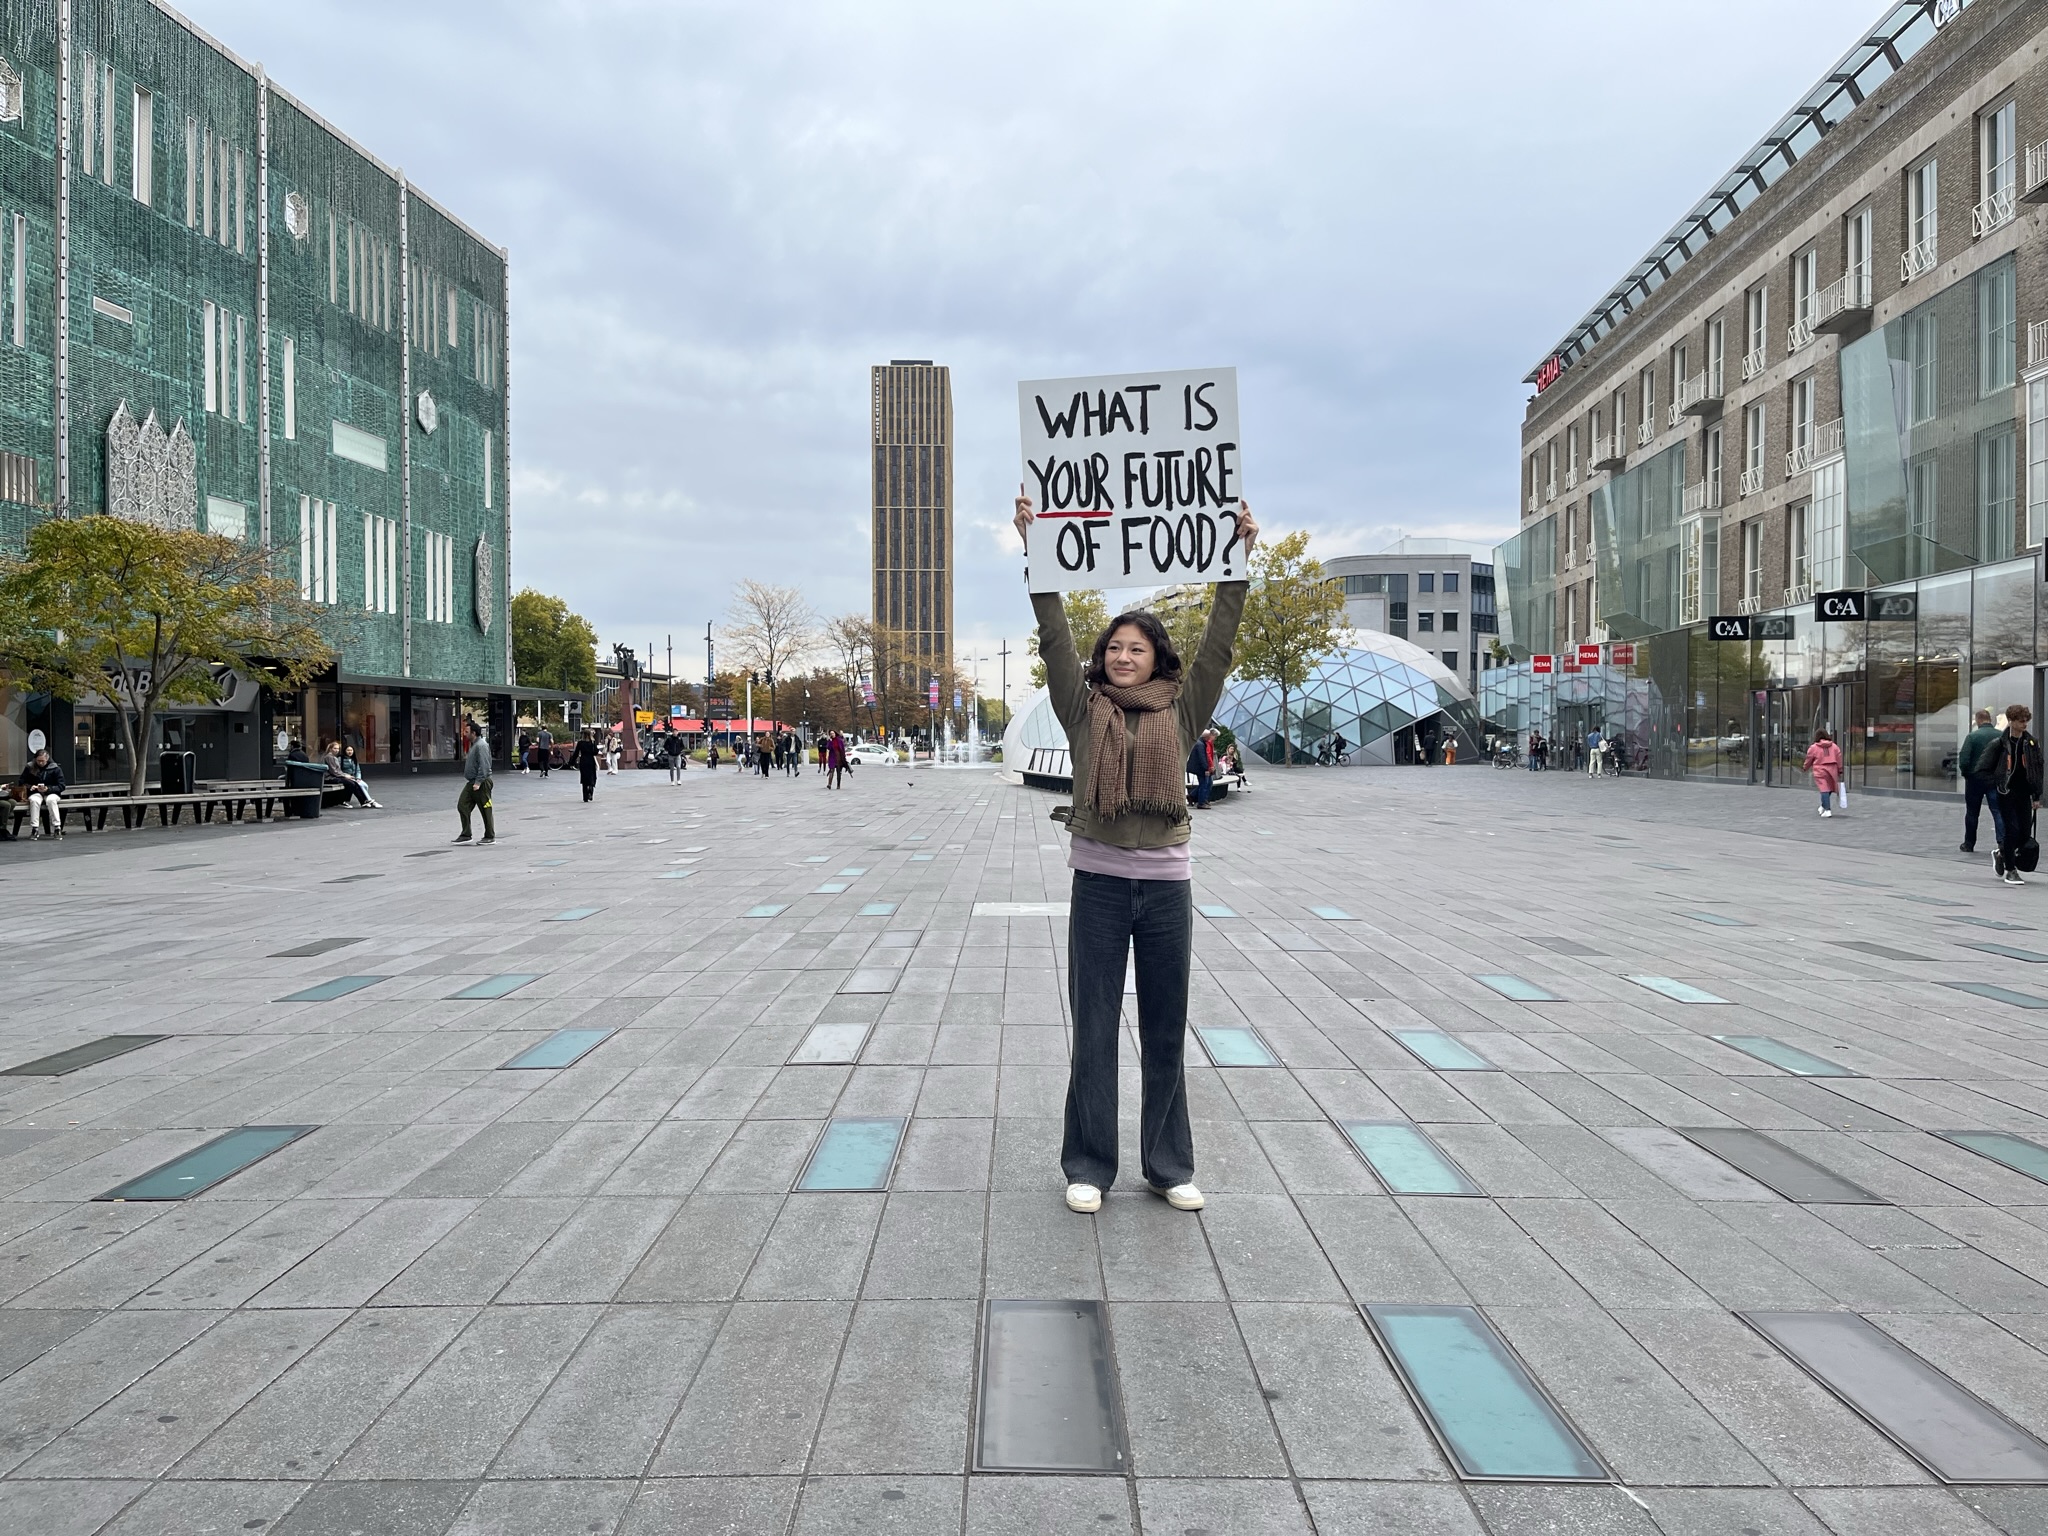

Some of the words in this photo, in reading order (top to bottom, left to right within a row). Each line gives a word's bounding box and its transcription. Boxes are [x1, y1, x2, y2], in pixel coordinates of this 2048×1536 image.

[1537, 356, 1560, 392] HEMA
[1035, 384, 1161, 439] WHAT
[1184, 382, 1218, 431] IS
[1027, 452, 1115, 512] YOUR
[1124, 442, 1239, 511] FUTURE
[1056, 520, 1110, 573] OF
[1121, 510, 1240, 576] FOOD?
[1715, 621, 1744, 636] C&A
[1823, 598, 1859, 616] C&A
